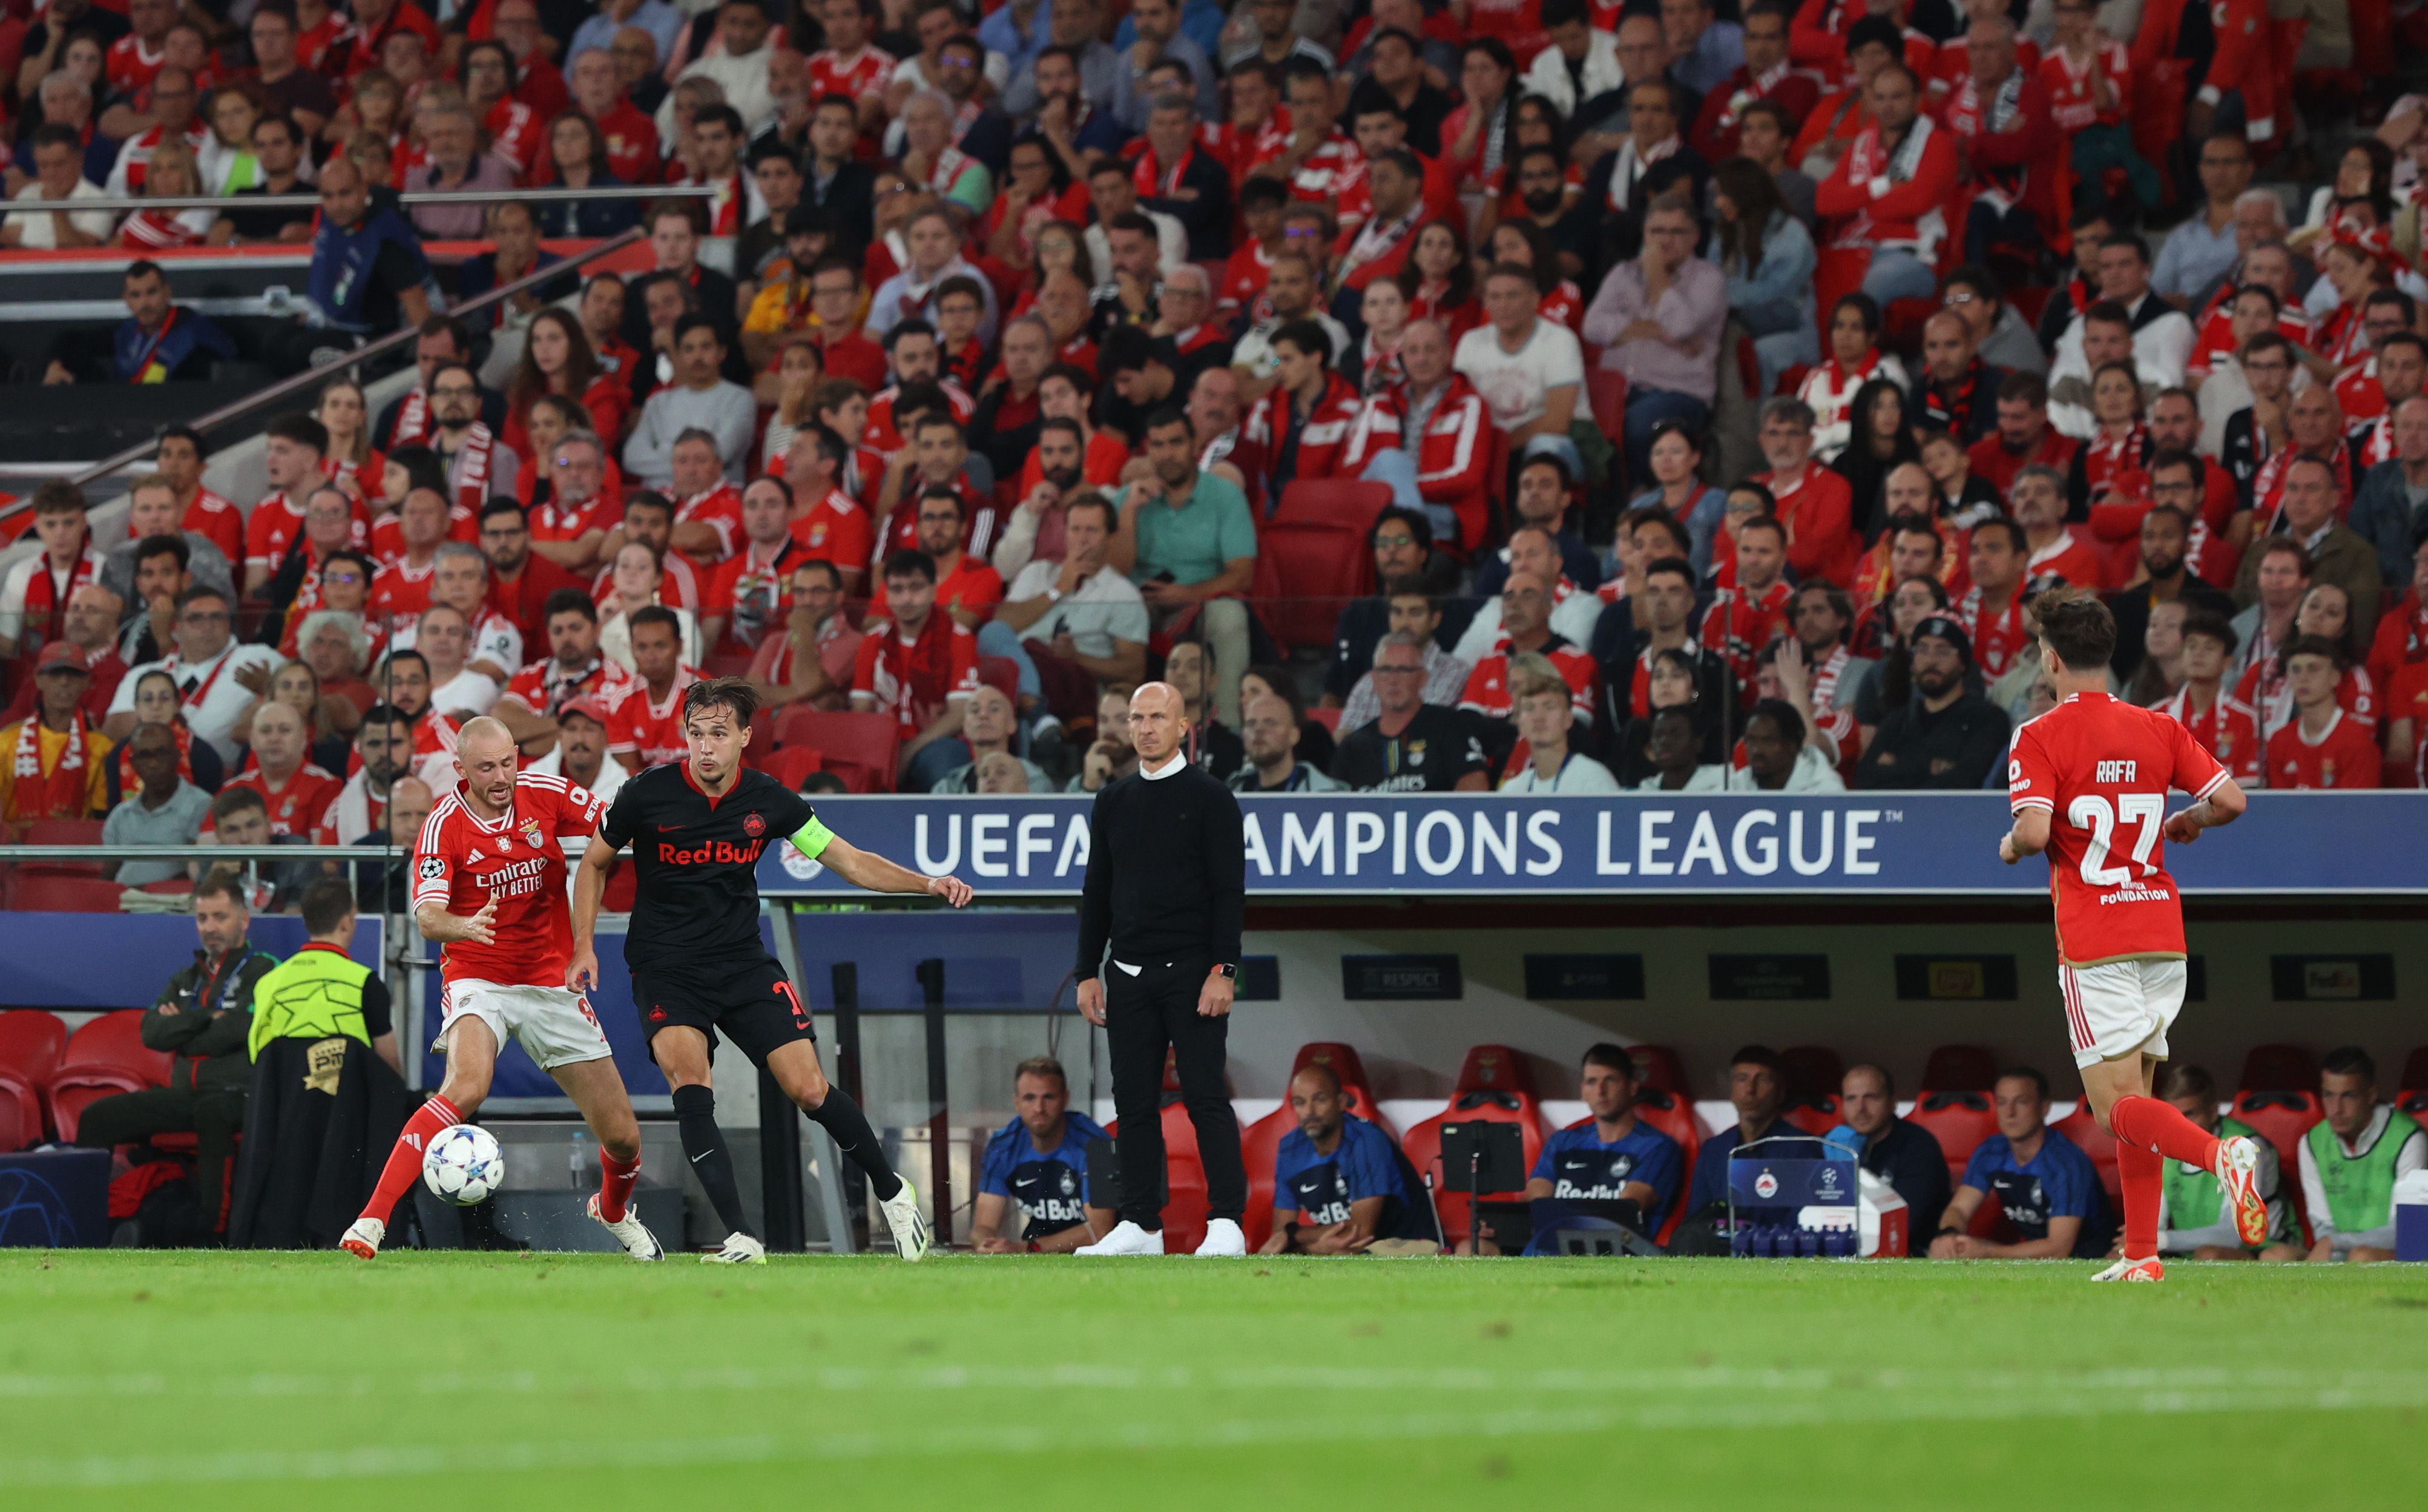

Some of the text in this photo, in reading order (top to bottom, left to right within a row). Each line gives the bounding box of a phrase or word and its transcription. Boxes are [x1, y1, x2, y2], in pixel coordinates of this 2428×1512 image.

[2096, 760, 2136, 783] RAFA
[658, 838, 764, 865] Red Bull
[1245, 810, 1564, 876] AMPIONS
[1596, 809, 1881, 876] LEAGUE
[2068, 793, 2165, 886] 27
[476, 856, 548, 887] Emirates
[2099, 889, 2170, 906] FOUNDATION
